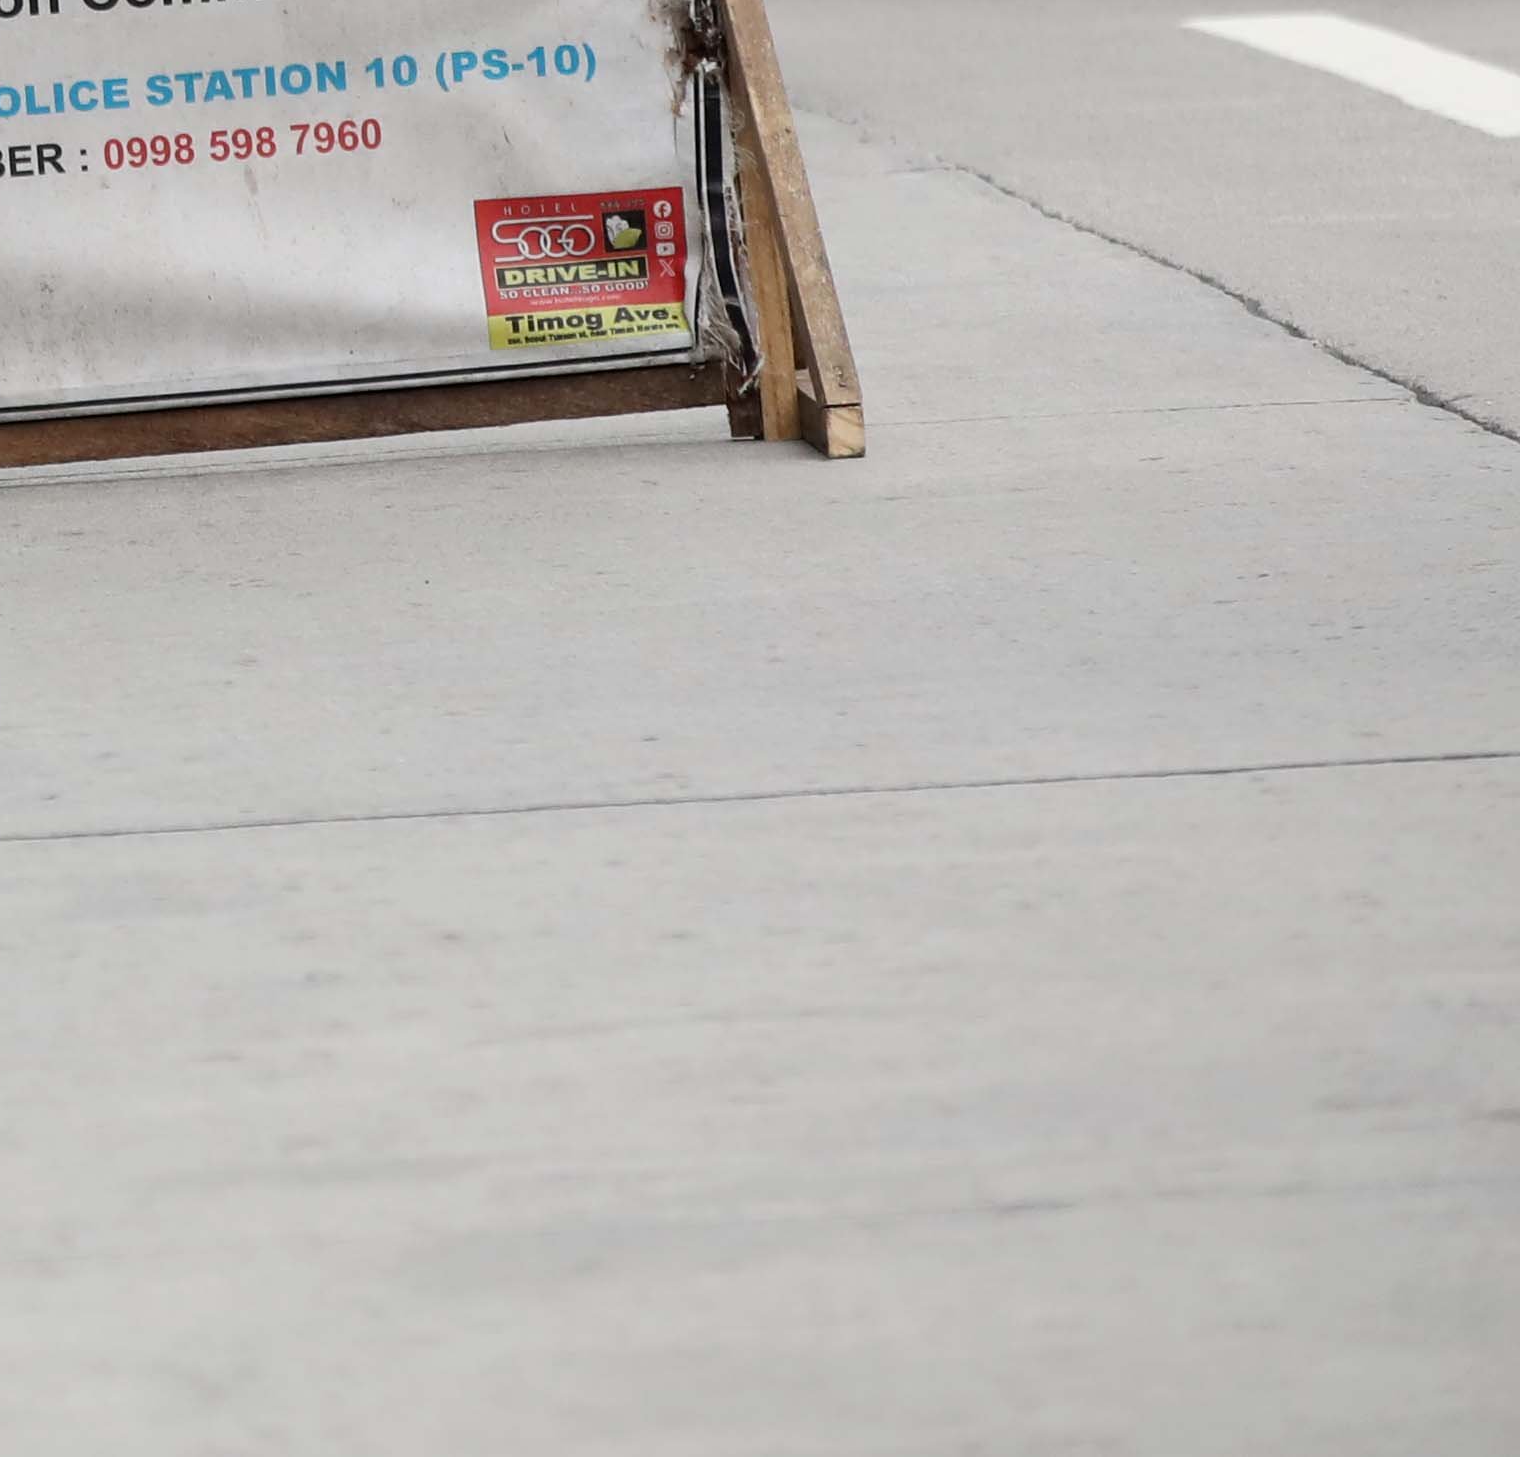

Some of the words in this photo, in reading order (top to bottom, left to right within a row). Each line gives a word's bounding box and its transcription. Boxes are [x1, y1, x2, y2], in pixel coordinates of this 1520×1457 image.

[147, 61, 346, 105] STATION
[366, 55, 417, 87] 10
[436, 44, 597, 91] (PS-10)
[104, 134, 194, 169] 0998
[211, 127, 276, 161] 598
[290, 119, 381, 154] 7960
[503, 204, 578, 216] HOTEL
[492, 214, 596, 263] SOGO
[504, 260, 640, 286] DRIVE-IN
[499, 289, 519, 300] SO
[604, 280, 650, 292] GOOD!
[504, 313, 603, 335] Timog
[614, 306, 679, 324] Ave.
